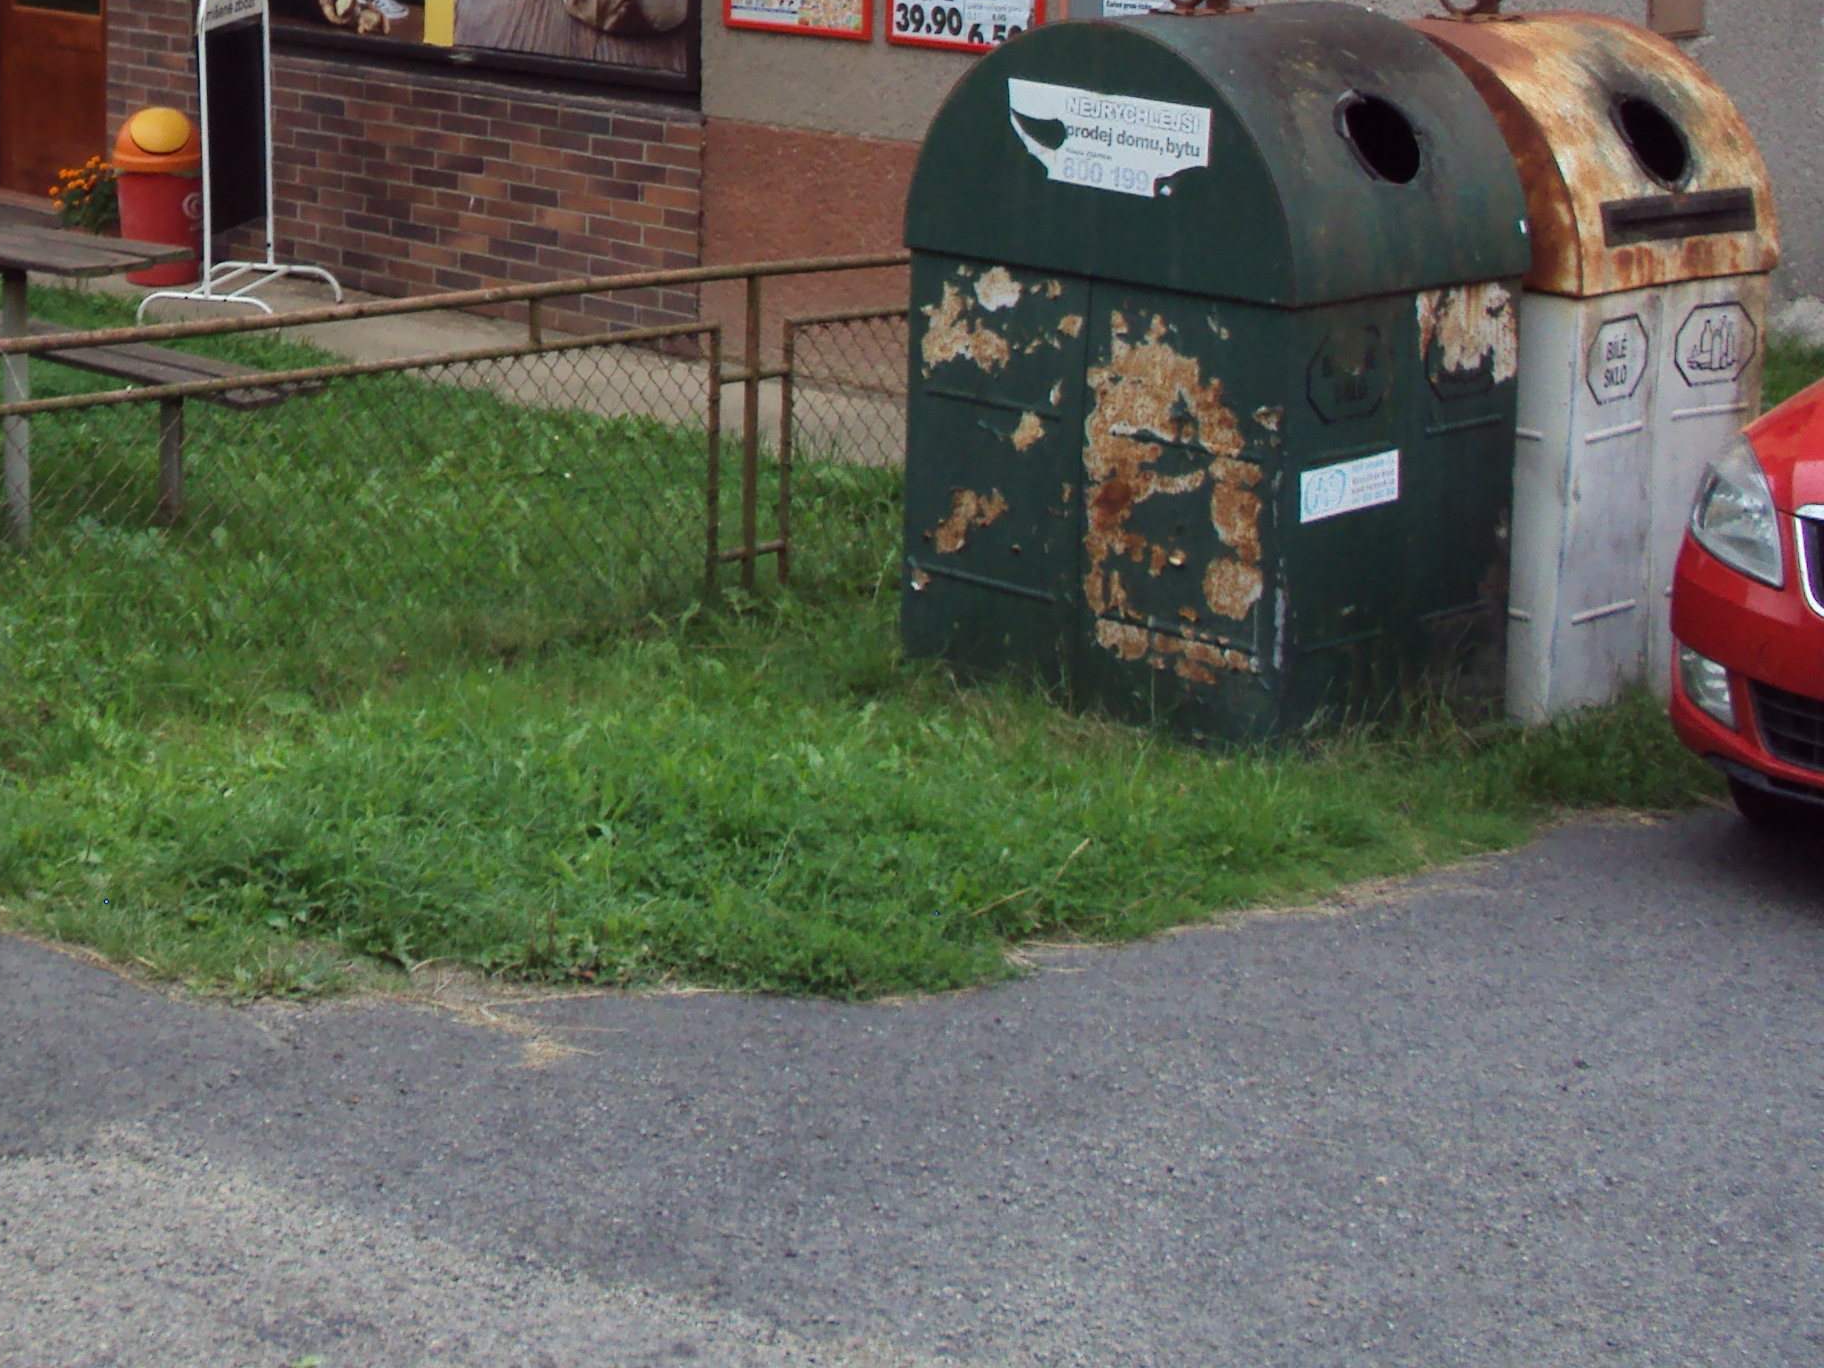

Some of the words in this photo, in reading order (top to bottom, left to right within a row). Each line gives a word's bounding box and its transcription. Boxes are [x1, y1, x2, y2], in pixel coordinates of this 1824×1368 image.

[896, 3, 962, 36] 39.90
[1065, 124, 1112, 147] prodej
[1116, 130, 1164, 155] domu,
[1166, 137, 1200, 158] bytu
[1063, 157, 1102, 184] 800
[1607, 333, 1626, 361] BÍLÉ
[1604, 365, 1627, 388] SKLO
